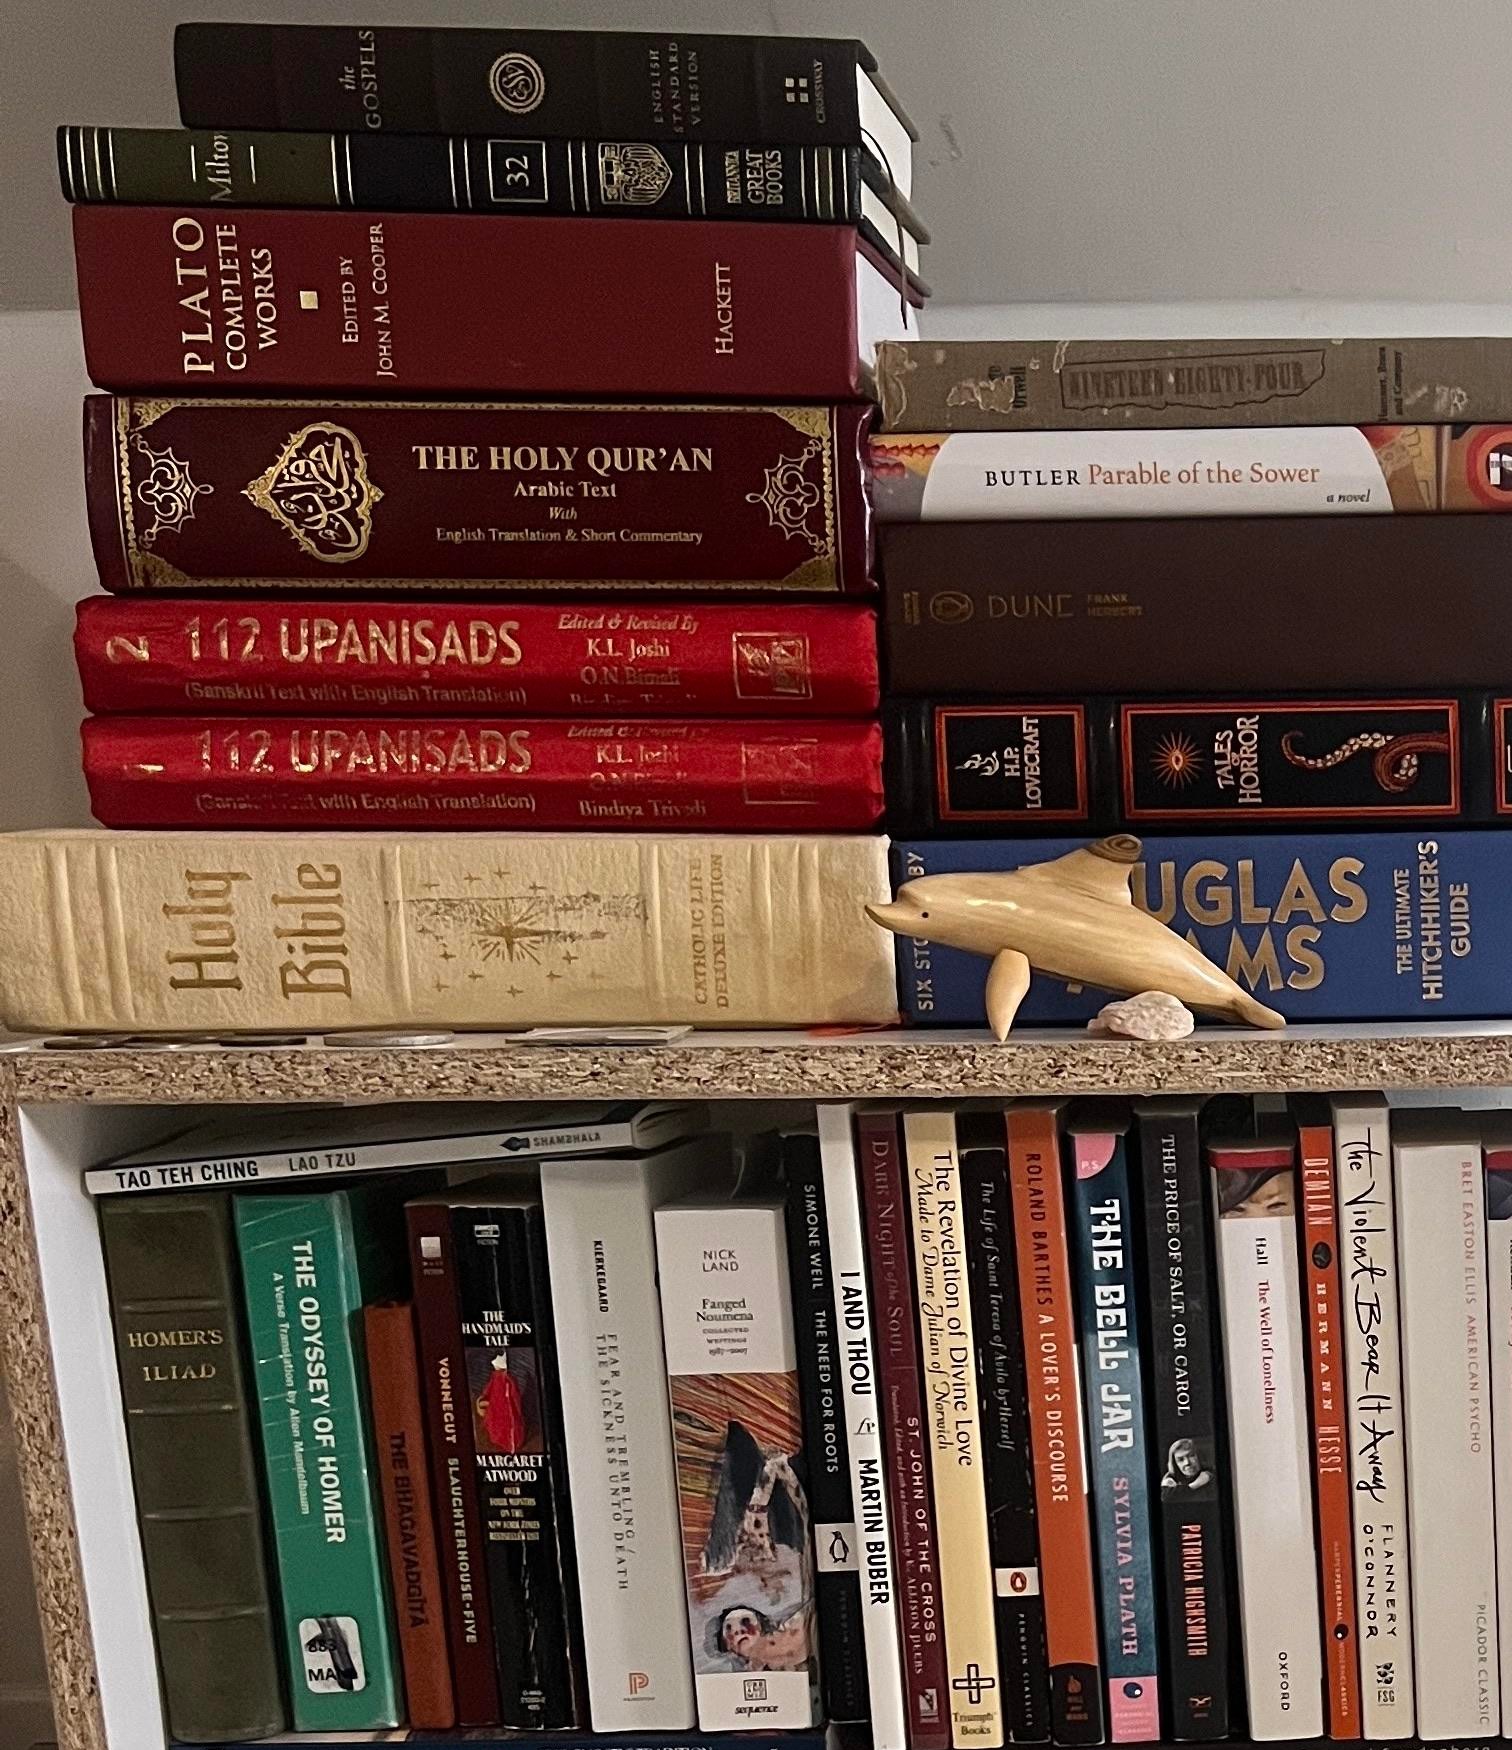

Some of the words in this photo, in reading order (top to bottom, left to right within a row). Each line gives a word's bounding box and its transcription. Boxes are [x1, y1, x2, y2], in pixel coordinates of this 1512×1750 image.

[359, 30, 381, 130] GOSPELS
[505, 154, 529, 186] 32
[746, 152, 764, 205] GREAT
[765, 149, 784, 204] BOOKS
[171, 217, 215, 373] PLATO
[219, 224, 246, 371] COMPLETE
[255, 247, 278, 349] WORKS
[715, 262, 733, 355] HACKETT
[412, 446, 478, 471] THE
[489, 447, 579, 472] HOLY
[586, 447, 712, 473] QUR'AN
[985, 467, 1080, 486] BUTLER
[1088, 461, 1171, 486] Parable
[1177, 461, 1201, 483] of
[1207, 461, 1243, 483] the
[1250, 461, 1319, 483] Sower
[514, 482, 572, 499] Arabic
[579, 482, 617, 498] Text
[1326, 493, 1333, 503] a
[1338, 489, 1370, 504] novel
[988, 594, 1072, 617] DUNE
[187, 618, 263, 662] 112
[279, 621, 522, 665] UPANISADS
[1025, 716, 1041, 808] LOVECRAFT
[1217, 730, 1233, 789] TALES
[1238, 714, 1258, 803] HORROR
[162, 867, 254, 993] Holy
[272, 861, 352, 999] Bible
[1422, 839, 1440, 999] HITCHHIKER'S
[1450, 882, 1468, 956] GUIDE
[116, 1172, 151, 1189] TAO
[159, 1167, 194, 1184] TEH
[201, 1161, 259, 1181] CHING
[288, 1155, 319, 1172] LAO
[322, 1152, 356, 1169] TZU
[933, 1151, 951, 1192] The
[293, 1241, 316, 1288] THE
[703, 1250, 736, 1259] NICK
[937, 1194, 960, 1310] Revelation
[1090, 1200, 1122, 1272] THE
[702, 1261, 738, 1272] LAND
[840, 1272, 859, 1280] I
[128, 1330, 223, 1348] HOMER'S
[841, 1286, 865, 1333] AND
[947, 1315, 966, 1338] of
[1095, 1286, 1124, 1370] BELL
[143, 1363, 216, 1382] ILIAD
[299, 1297, 329, 1412] ODYSSEY
[847, 1335, 871, 1396] THOU
[950, 1342, 970, 1410] Divine
[314, 1419, 335, 1450] OF
[956, 1415, 972, 1467] Love
[1101, 1378, 1134, 1454] JAR
[476, 1455, 543, 1467] MARGARET
[484, 1471, 536, 1482] ATWOOD
[318, 1456, 345, 1543] HOMER
[859, 1459, 882, 1533] MARTIN
[1112, 1476, 1133, 1566] SYLVIA
[866, 1538, 889, 1606] BUBER
[1363, 1524, 1378, 1639] O'CONNOR
[1381, 1524, 1397, 1637] FLANNERY
[1119, 1576, 1138, 1657] PLATH
[1278, 1652, 1289, 1711] OXFORD
